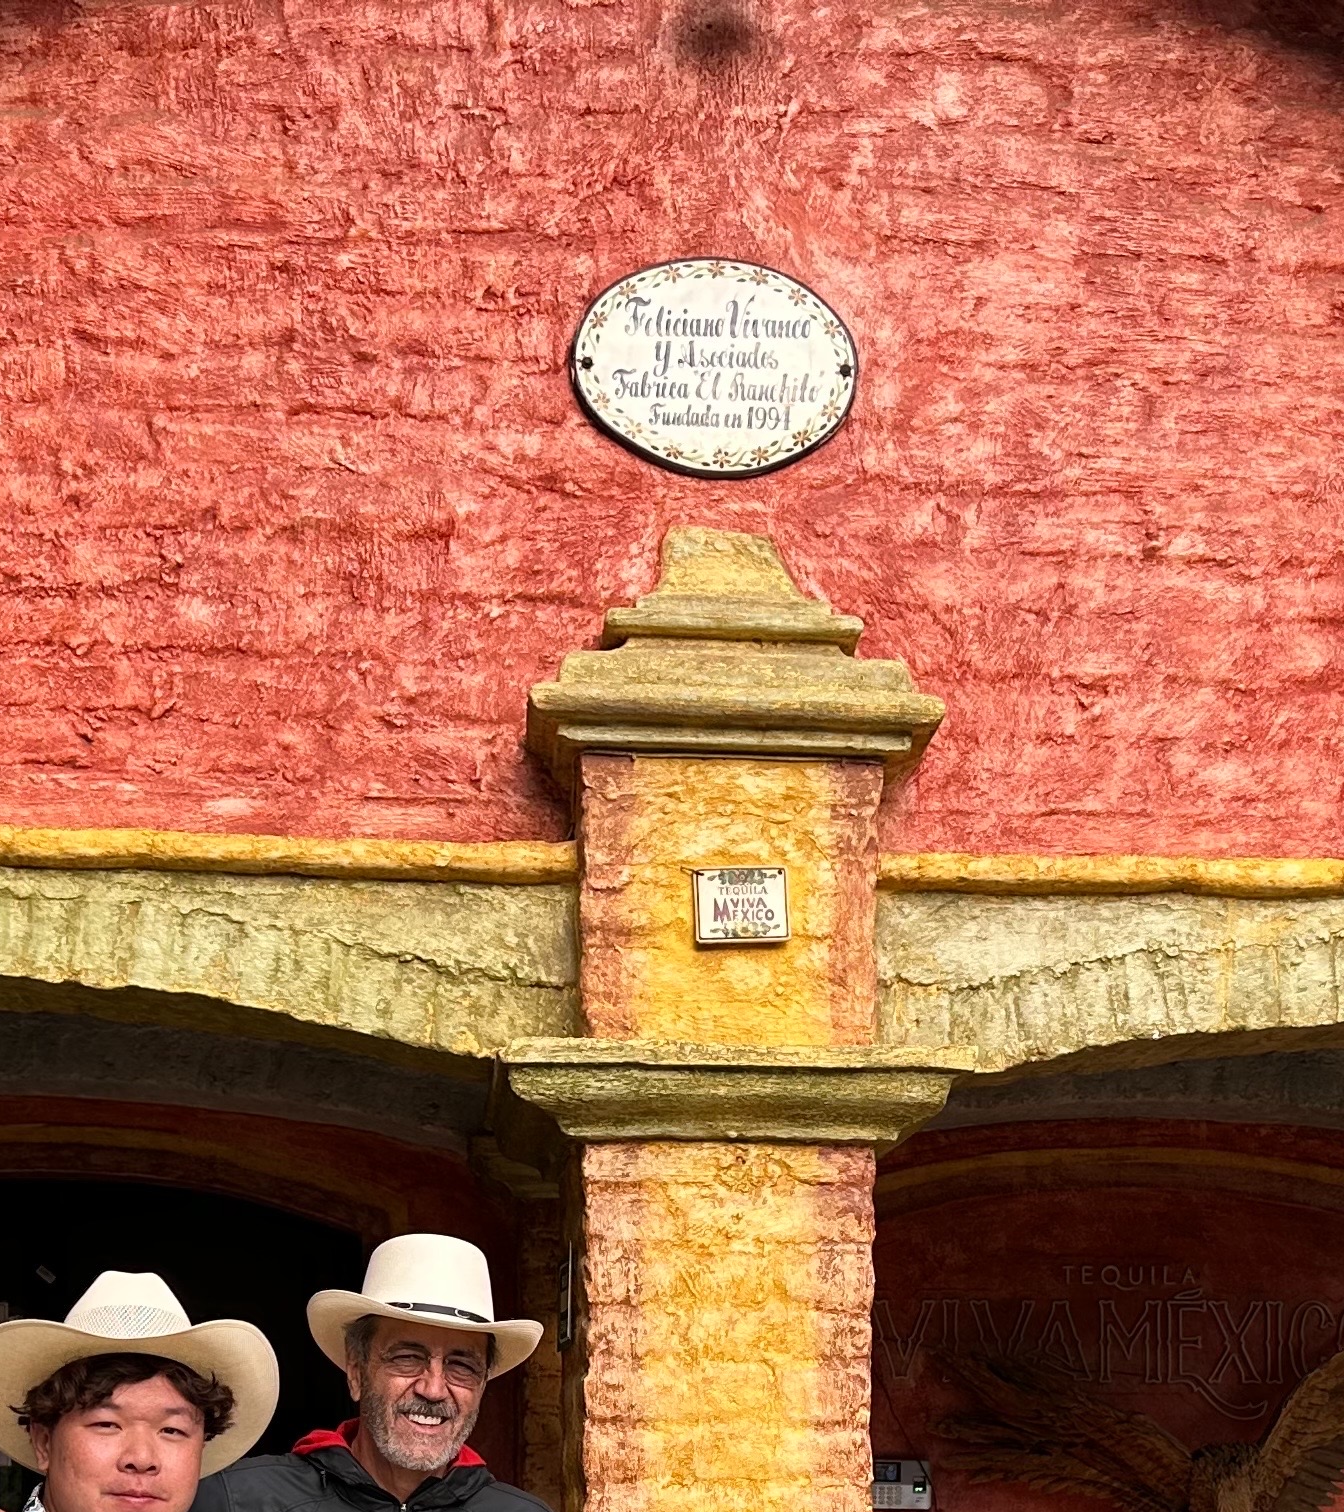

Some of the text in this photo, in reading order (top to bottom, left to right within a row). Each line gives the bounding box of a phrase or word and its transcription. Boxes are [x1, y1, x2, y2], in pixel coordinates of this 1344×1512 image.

[624, 294, 812, 339] Feliciano Vivanco
[678, 340, 779, 370] Asociados
[612, 368, 689, 400] Fabrica
[648, 403, 721, 428] Fundada
[724, 411, 743, 429] en
[718, 886, 768, 896] TEQUILA
[730, 897, 767, 909] VIVA
[1062, 1265, 1196, 1291] TEQUILA
